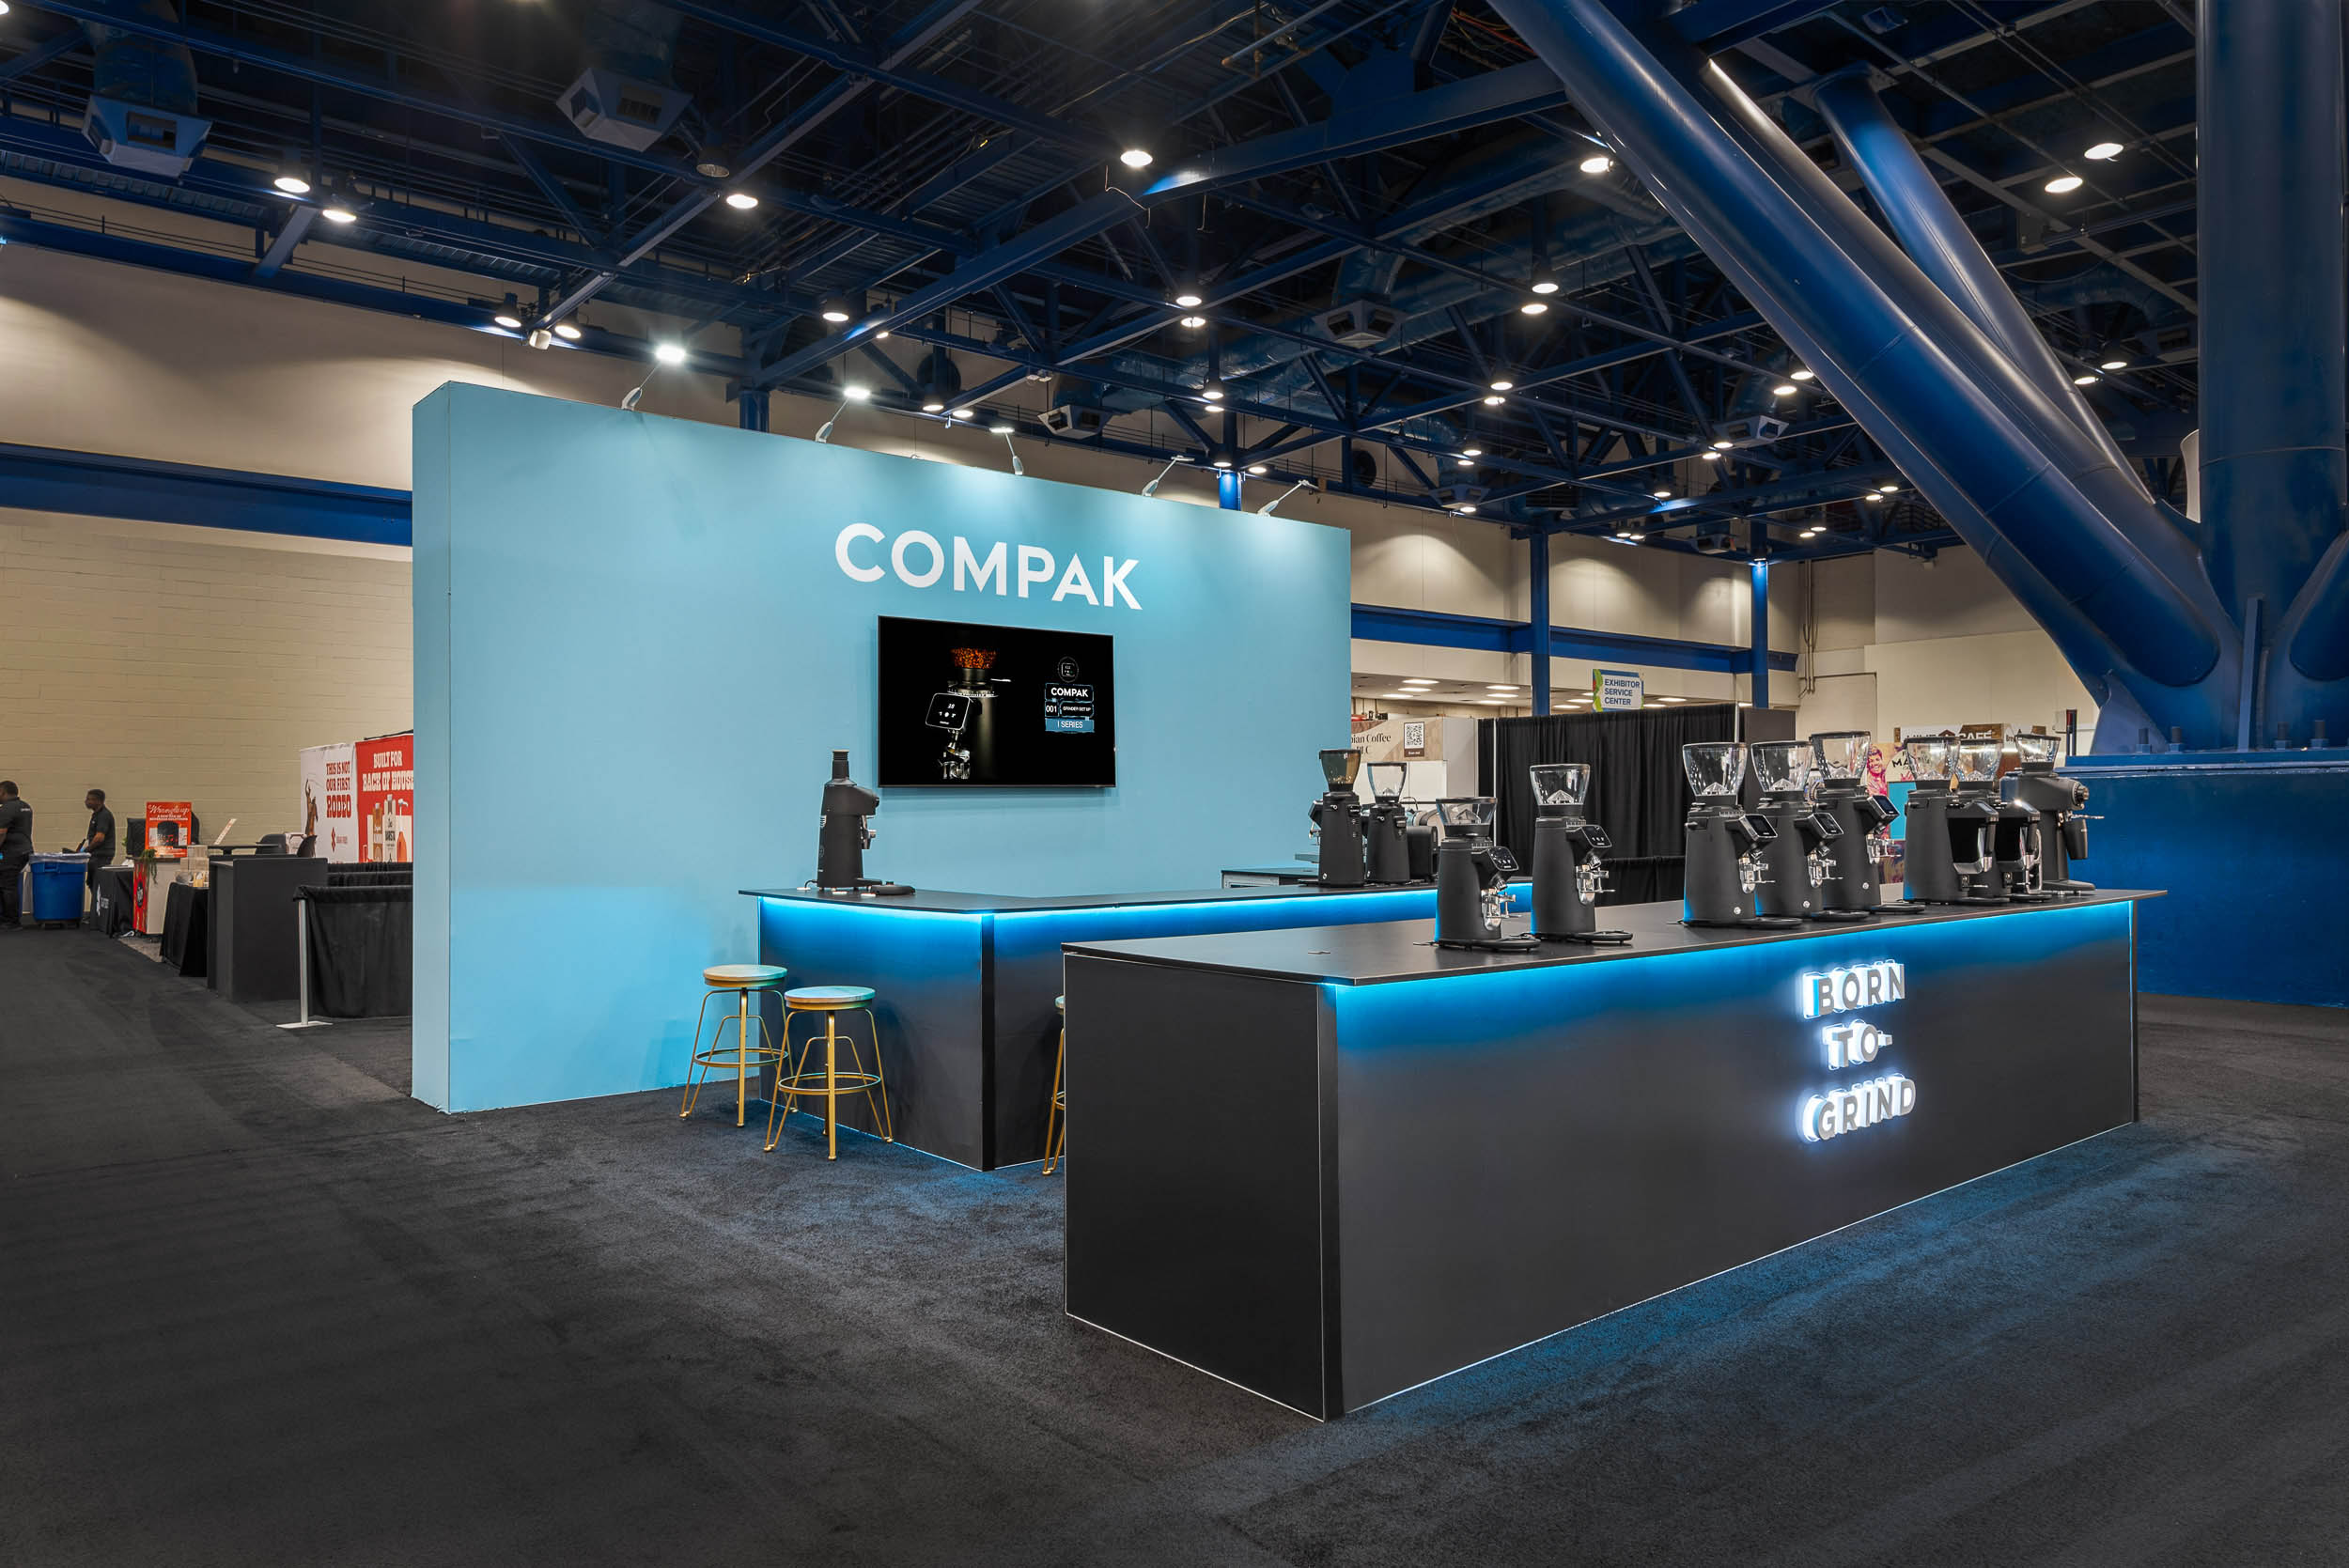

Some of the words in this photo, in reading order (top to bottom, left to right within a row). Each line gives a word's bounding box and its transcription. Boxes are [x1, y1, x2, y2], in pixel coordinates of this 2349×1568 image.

[834, 522, 1143, 610] COMPAK
[1604, 678, 1640, 688] EXHIBITOR
[1050, 687, 1089, 697] COMPAK
[1604, 688, 1633, 696] SERVICE
[1604, 696, 1631, 705] CENTER
[1045, 705, 1057, 713] 001
[1061, 721, 1083, 729] SERIES
[1366, 733, 1392, 743] Coffee
[373, 751, 390, 768] BUILT
[390, 750, 403, 768] FOR
[326, 762, 336, 775] THIS
[336, 762, 342, 775] IS
[342, 761, 350, 774] NOT
[326, 778, 336, 791] OUR
[336, 777, 350, 790] FIRST
[362, 772, 381, 792] BACK
[381, 771, 391, 791] OF
[326, 794, 352, 818] RODEO
[1804, 960, 1906, 1018] BORN
[1803, 1074, 1917, 1141] GRIND
